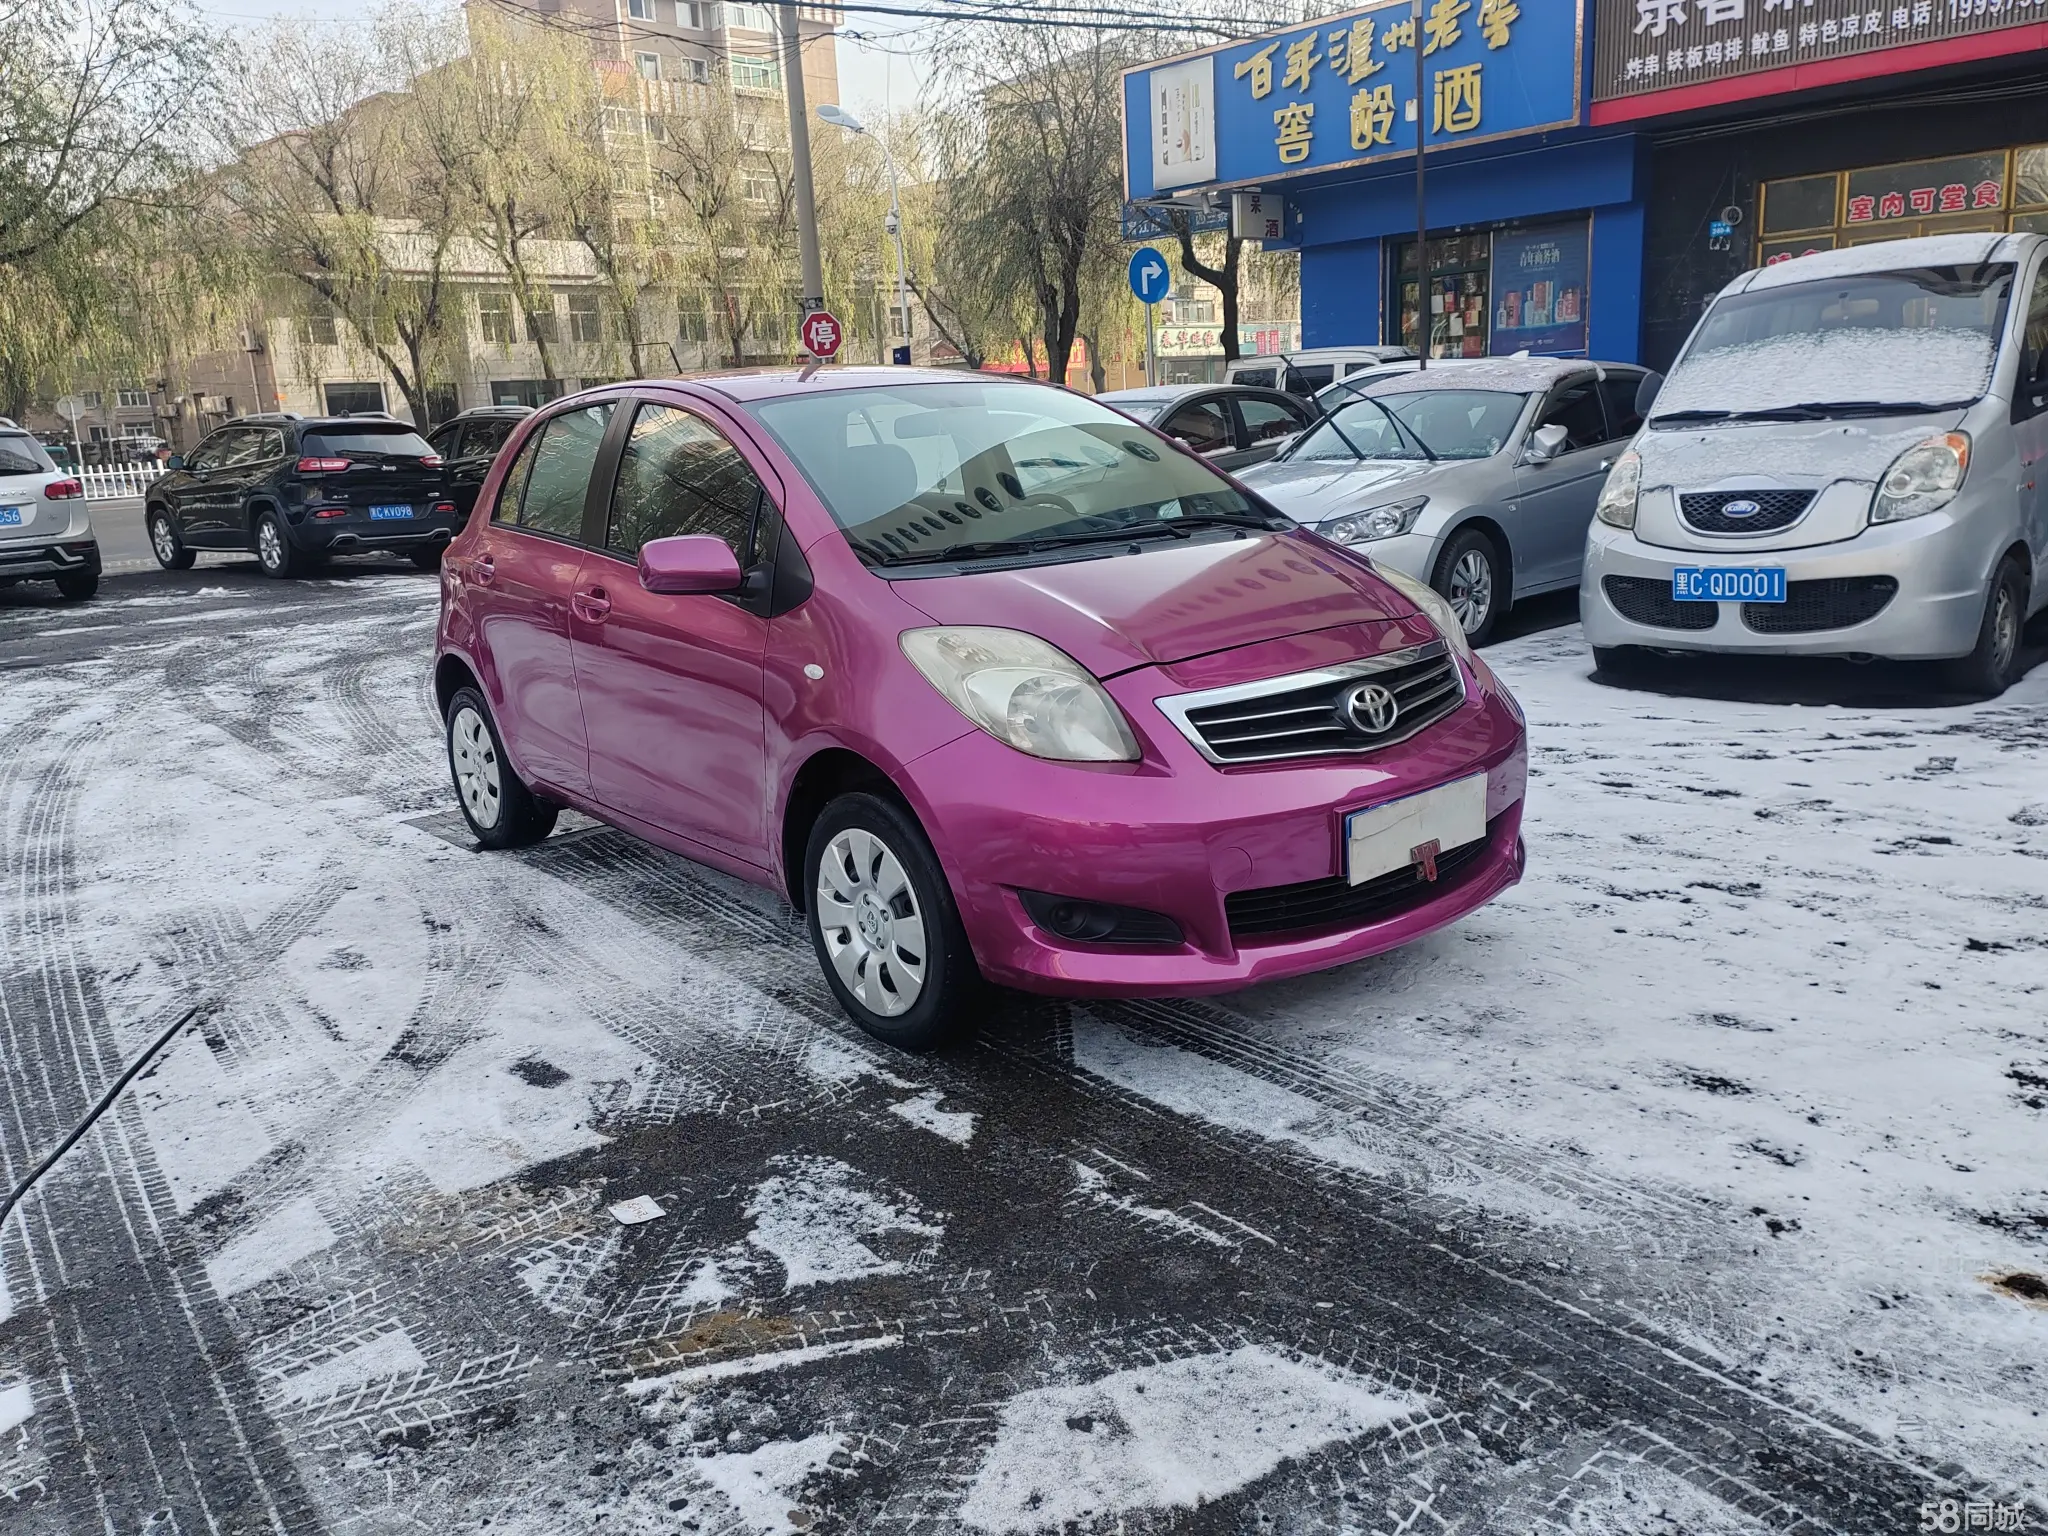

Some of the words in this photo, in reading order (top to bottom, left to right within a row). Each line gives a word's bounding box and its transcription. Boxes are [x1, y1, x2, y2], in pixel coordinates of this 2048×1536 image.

[1626, 53, 1660, 80] 炸串
[1666, 37, 1743, 73] 铁板鸡排
[1751, 28, 1790, 56] 鱿鱼
[1798, 9, 1883, 48] 特色凉皮
[1848, 180, 2000, 222] 室内可堂食
[809, 320, 836, 350] 停
